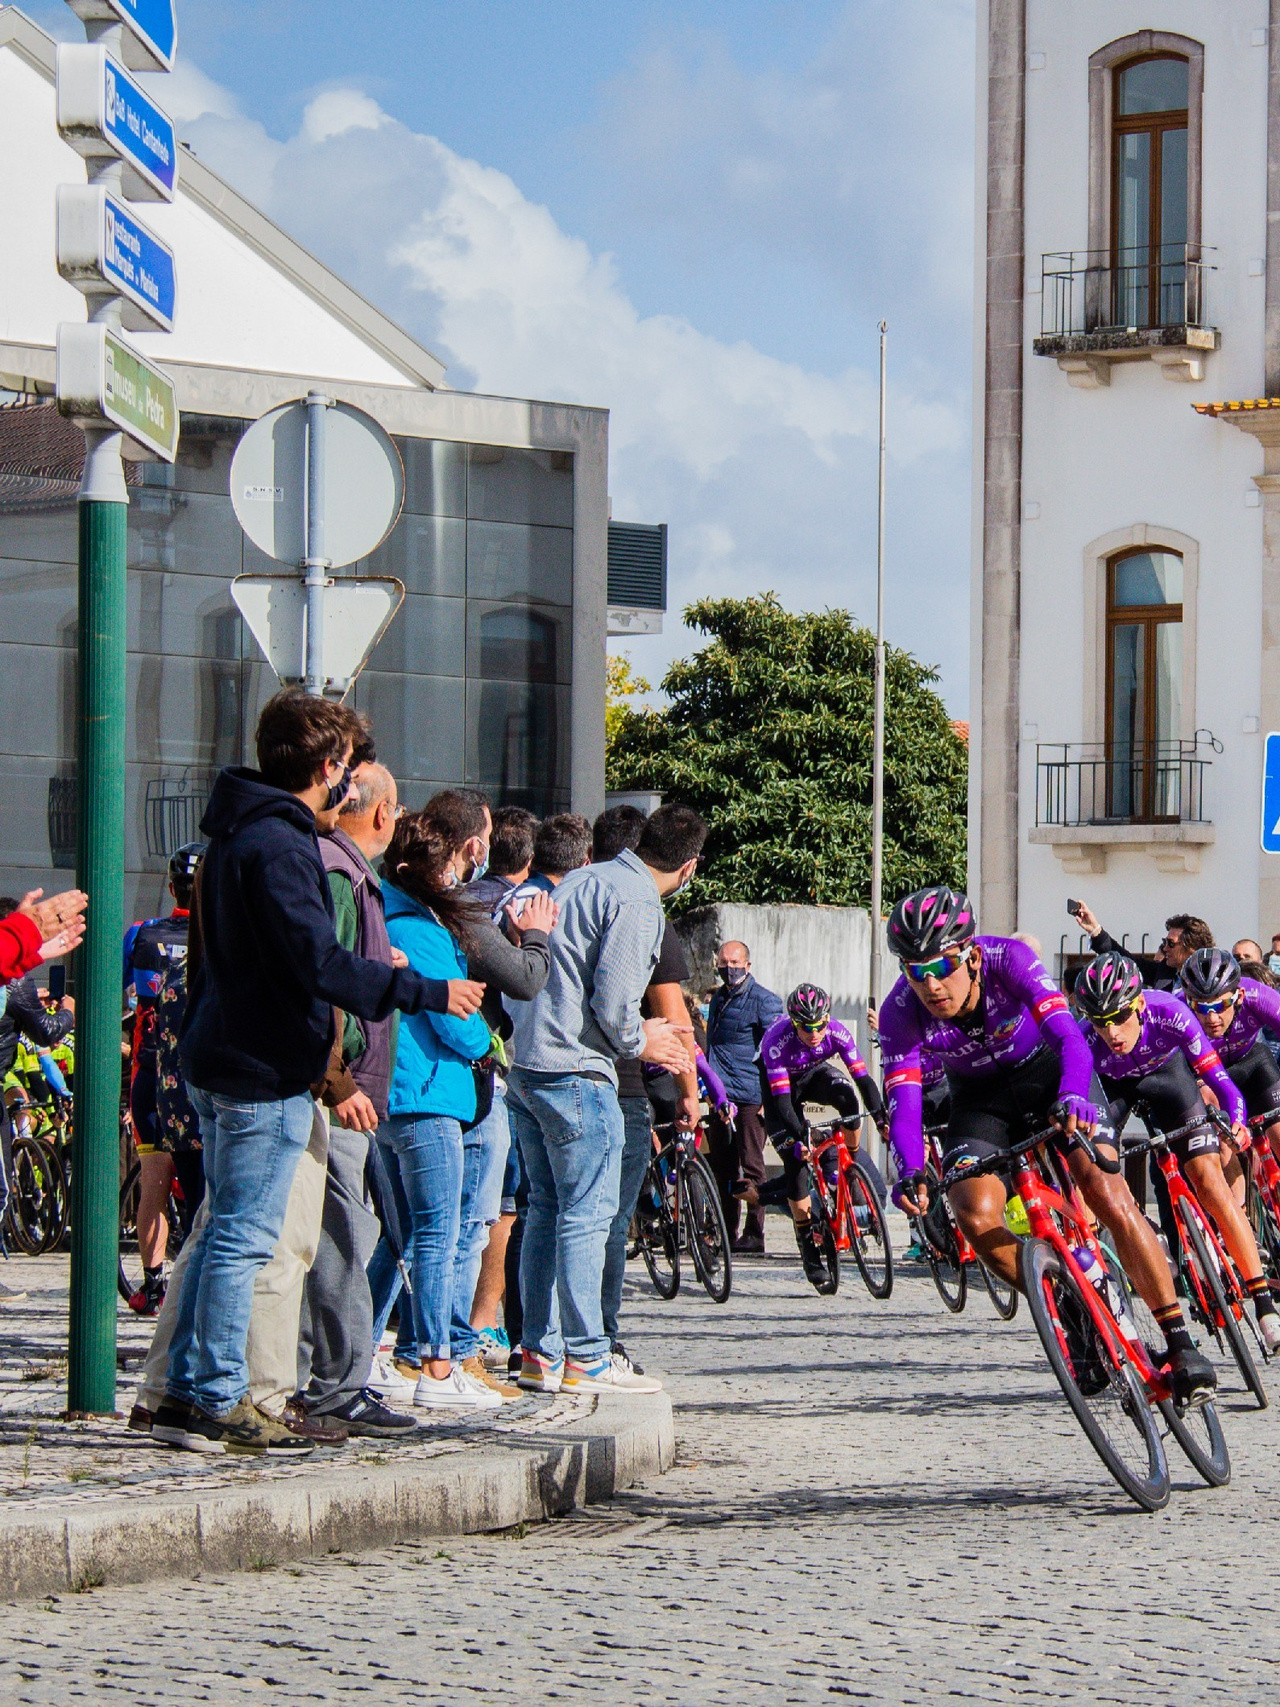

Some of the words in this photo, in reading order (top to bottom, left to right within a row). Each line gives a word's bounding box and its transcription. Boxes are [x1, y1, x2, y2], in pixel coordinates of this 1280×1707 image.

[127, 105, 141, 139] Hotel
[115, 220, 141, 258] restaurante
[114, 369, 136, 408] museu
[146, 386, 165, 431] Pedra
[1188, 1133, 1219, 1151] BH
